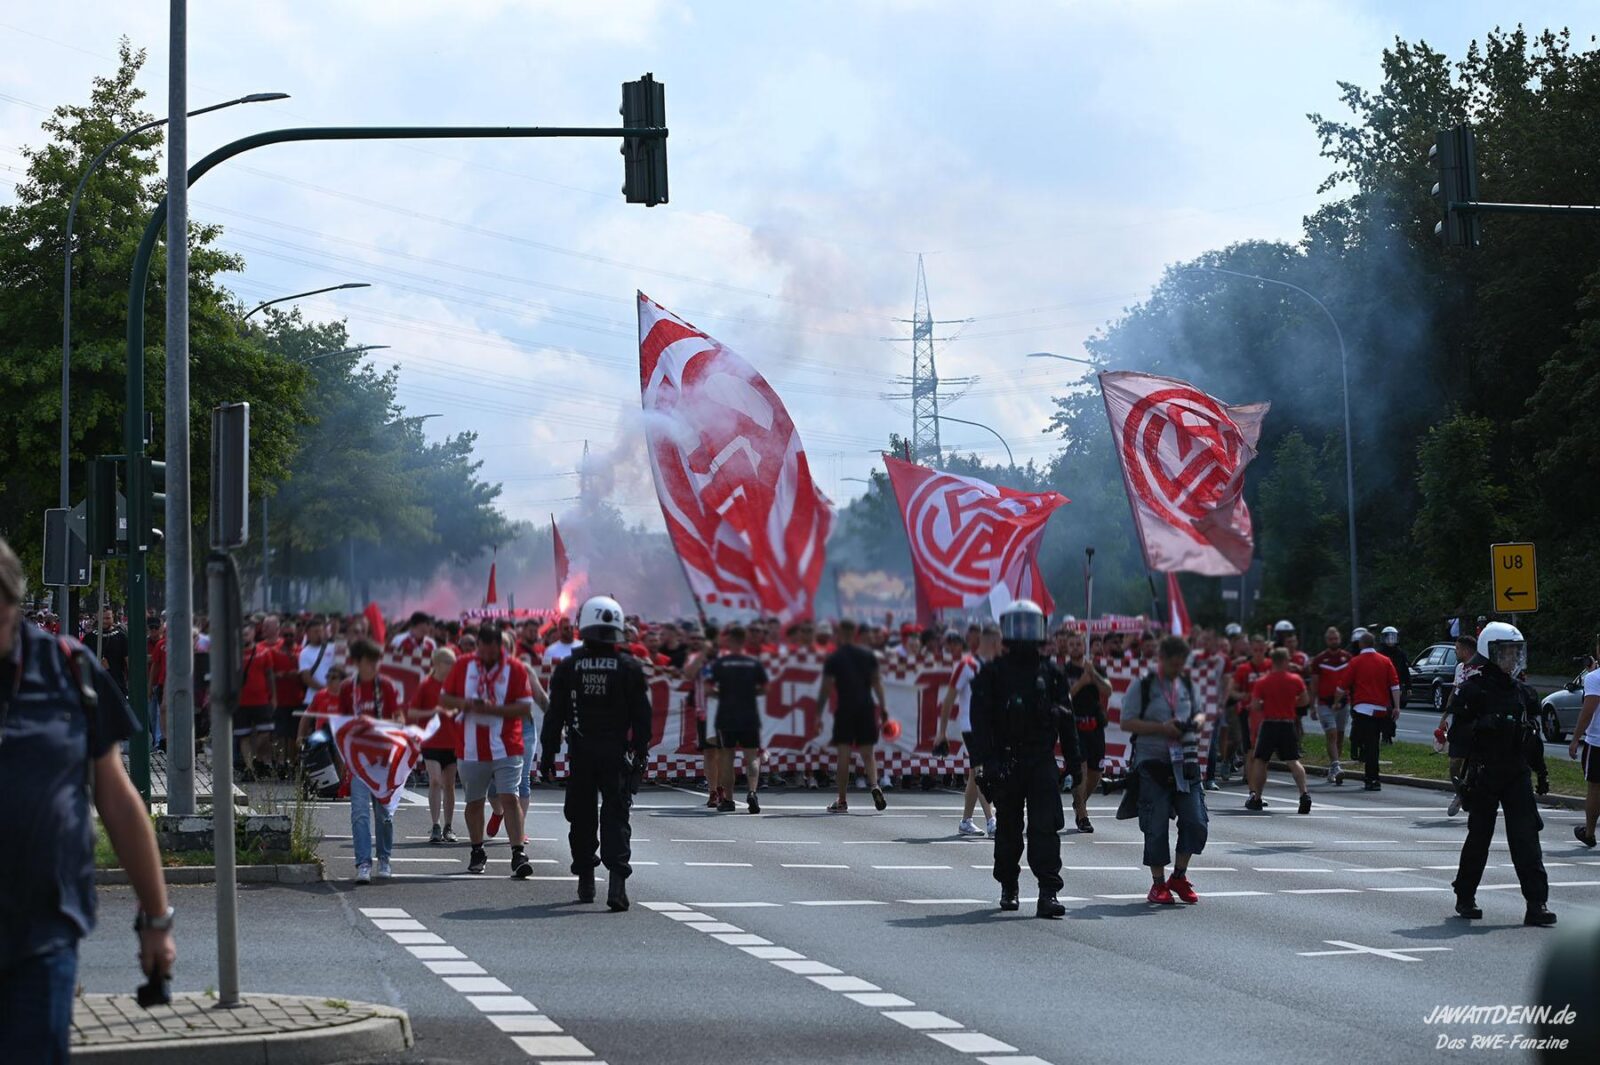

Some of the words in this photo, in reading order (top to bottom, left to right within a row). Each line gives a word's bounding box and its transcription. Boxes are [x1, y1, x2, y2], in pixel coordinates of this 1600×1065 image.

[1503, 555, 1523, 569] U8
[135, 574, 141, 583] 7
[575, 657, 618, 671] POLIZEI
[582, 673, 608, 684] NRW
[584, 684, 606, 694] 2721
